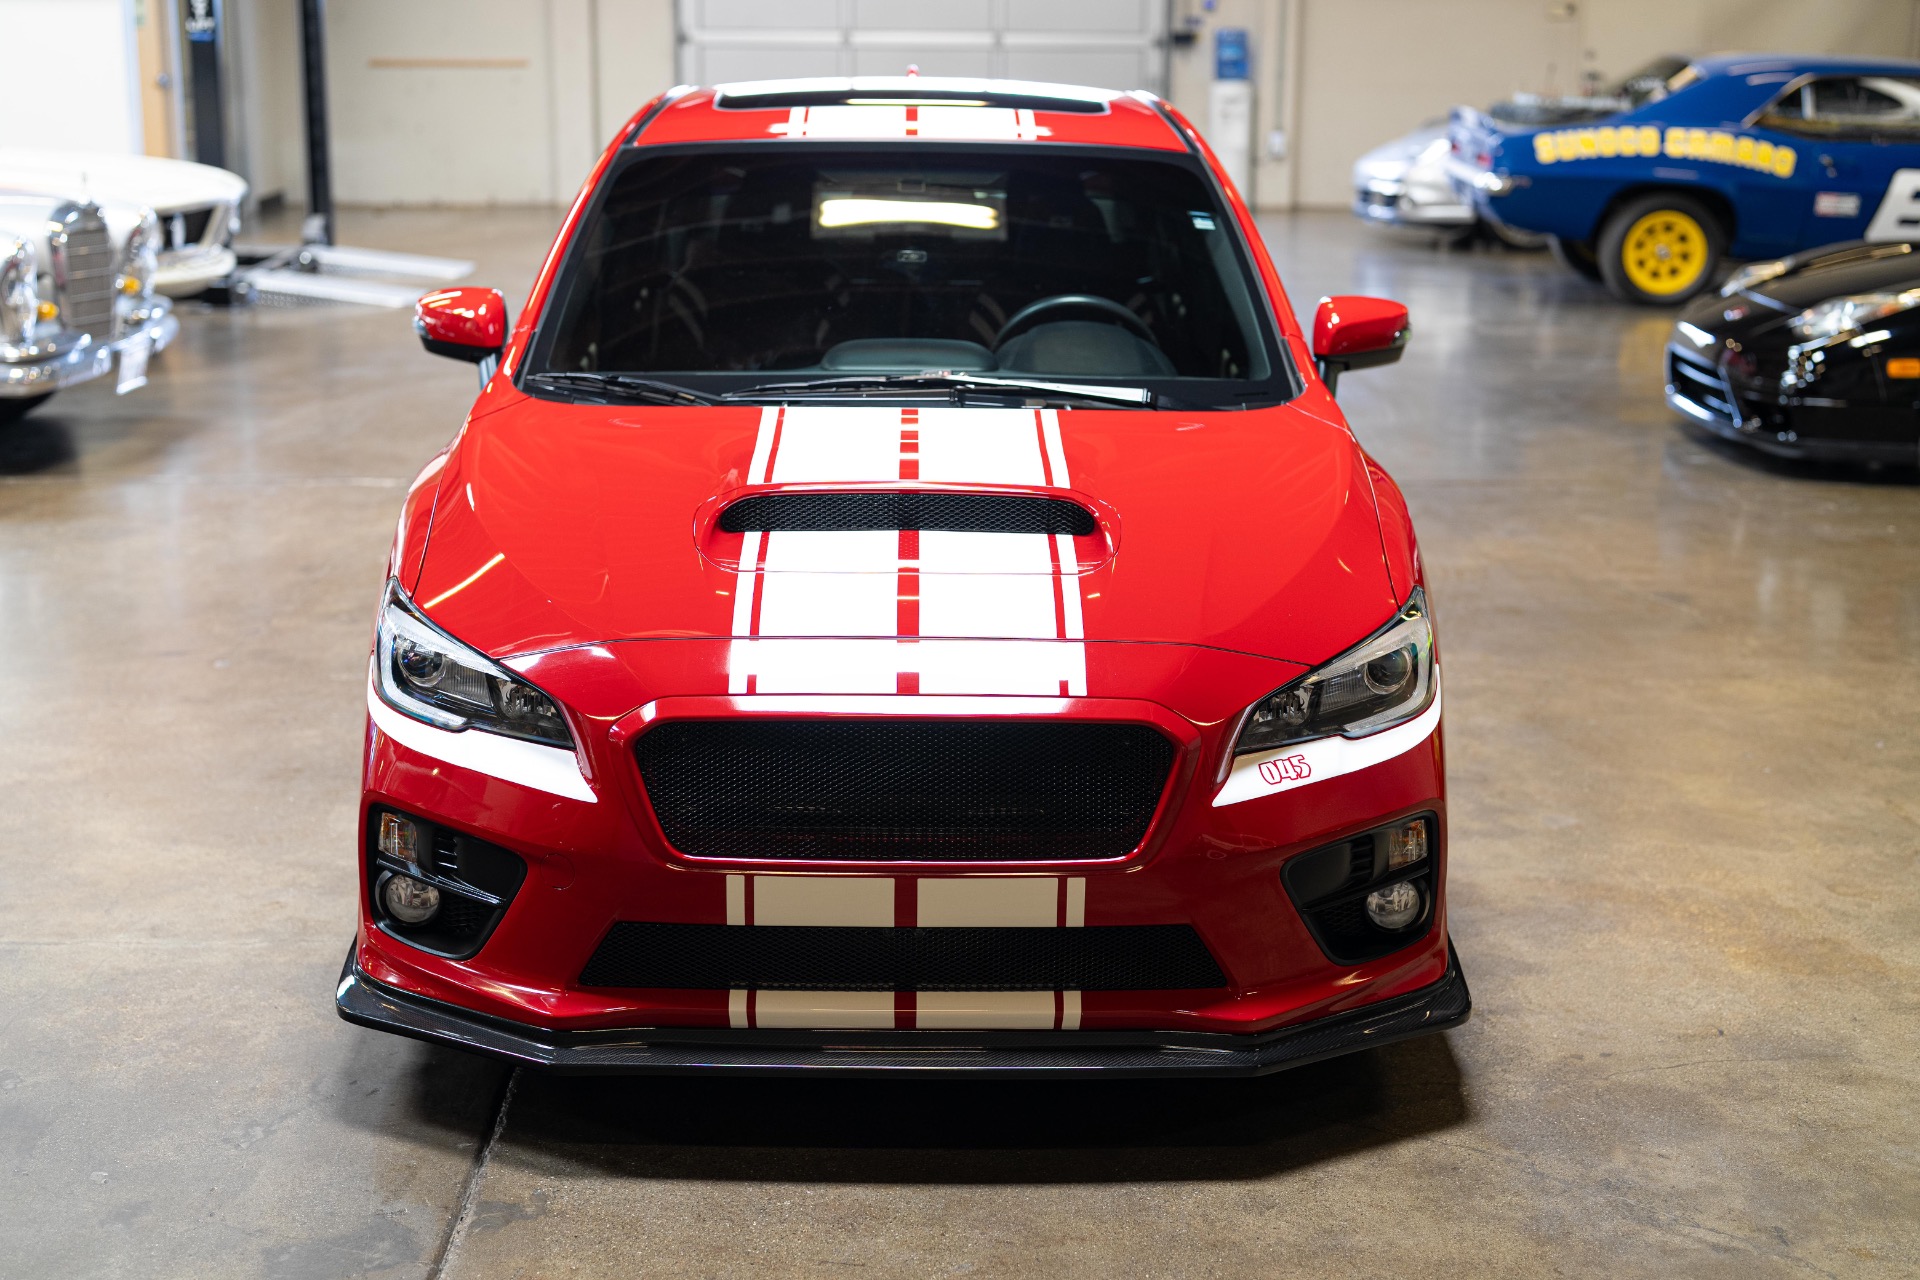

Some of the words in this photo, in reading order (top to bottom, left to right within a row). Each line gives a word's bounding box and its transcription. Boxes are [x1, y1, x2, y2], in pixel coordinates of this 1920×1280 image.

[1534, 126, 1661, 164] SUNOCO
[1664, 127, 1797, 178] CAMARO
[1258, 754, 1311, 785] 045
